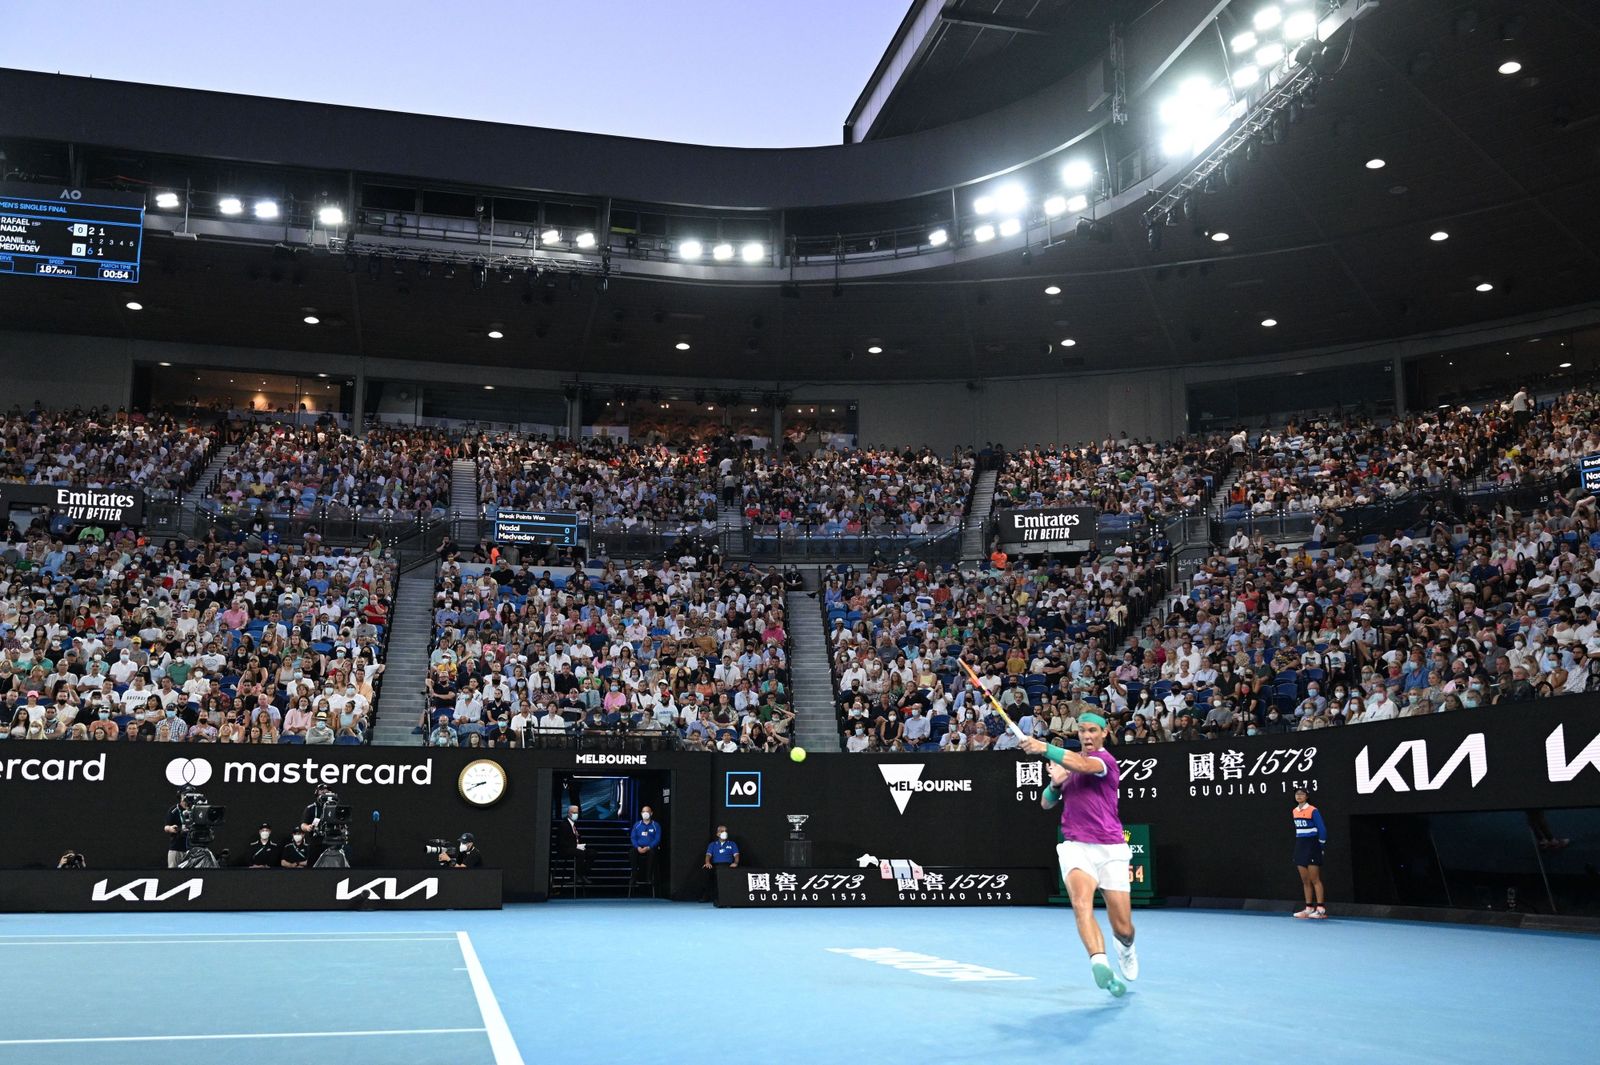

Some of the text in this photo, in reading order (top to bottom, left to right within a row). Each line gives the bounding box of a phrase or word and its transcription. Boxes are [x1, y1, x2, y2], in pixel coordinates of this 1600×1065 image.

[20, 203, 47, 211] SINGLES
[48, 205, 68, 213] FINAL
[1, 217, 30, 226] RAFAEL
[0, 224, 27, 233] NADAL
[88, 227, 95, 235] 2
[99, 228, 105, 236] 1
[0, 235, 24, 244] DANIIL
[0, 243, 40, 252] MEDVEDEV
[97, 248, 103, 256] 1
[103, 270, 129, 279] 00:54
[57, 489, 135, 508] Emirates
[67, 507, 84, 519] FLY
[1014, 513, 1080, 529] Emirates
[499, 524, 520, 532] Nadal
[498, 532, 535, 541] Medvedev
[1024, 527, 1070, 540] FLY BETTER
[576, 754, 647, 765] MELBOURNE
[223, 758, 433, 785] mastercard
[887, 779, 972, 793] MELBOURNE
[1189, 782, 1267, 797] GUOJIAO
[748, 893, 867, 901] GUOJIAO 1573
[898, 892, 1012, 901] GUOJIAO 1573
